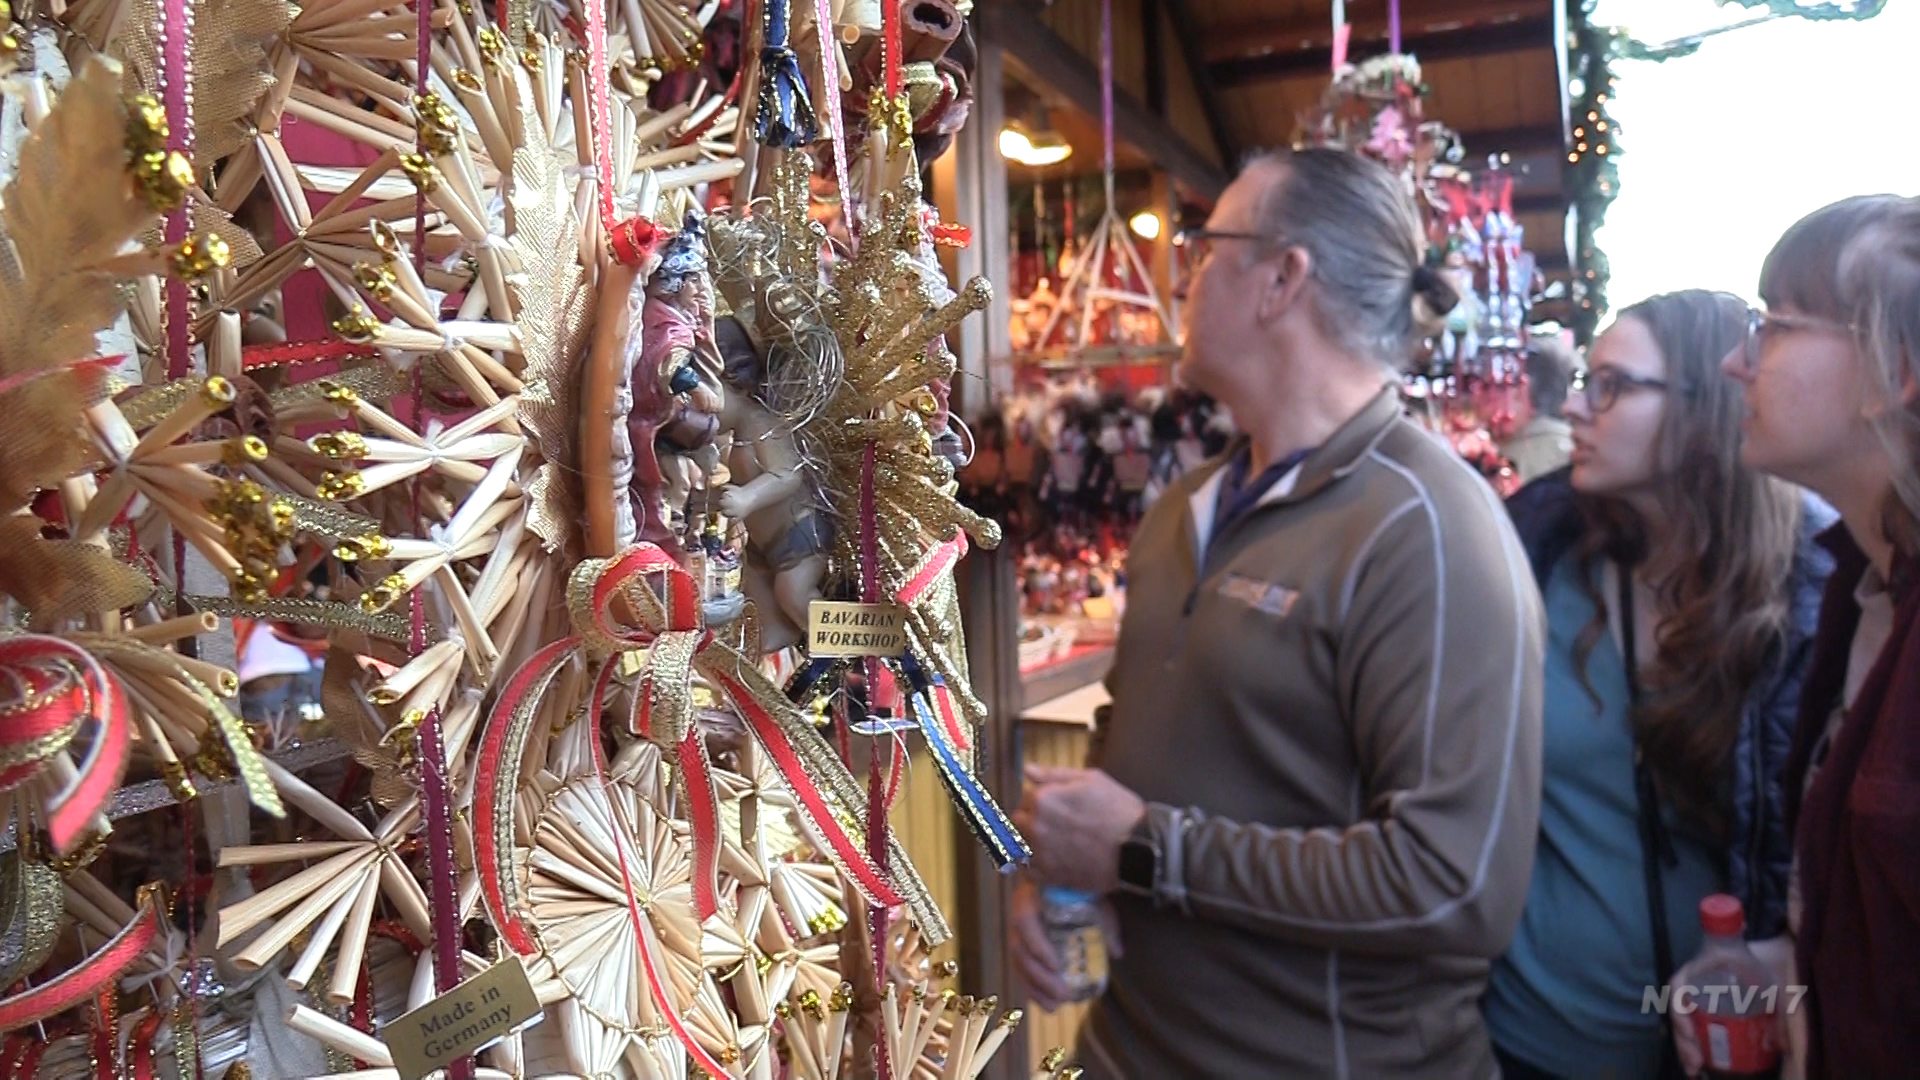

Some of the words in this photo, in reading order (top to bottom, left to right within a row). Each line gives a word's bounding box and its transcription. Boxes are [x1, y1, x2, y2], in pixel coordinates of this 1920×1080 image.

[820, 611, 896, 626] BAVARIAN
[816, 631, 899, 647] WORKSHOP
[420, 1001, 476, 1037] Made
[481, 986, 500, 1004] in
[425, 1004, 511, 1057] Germany
